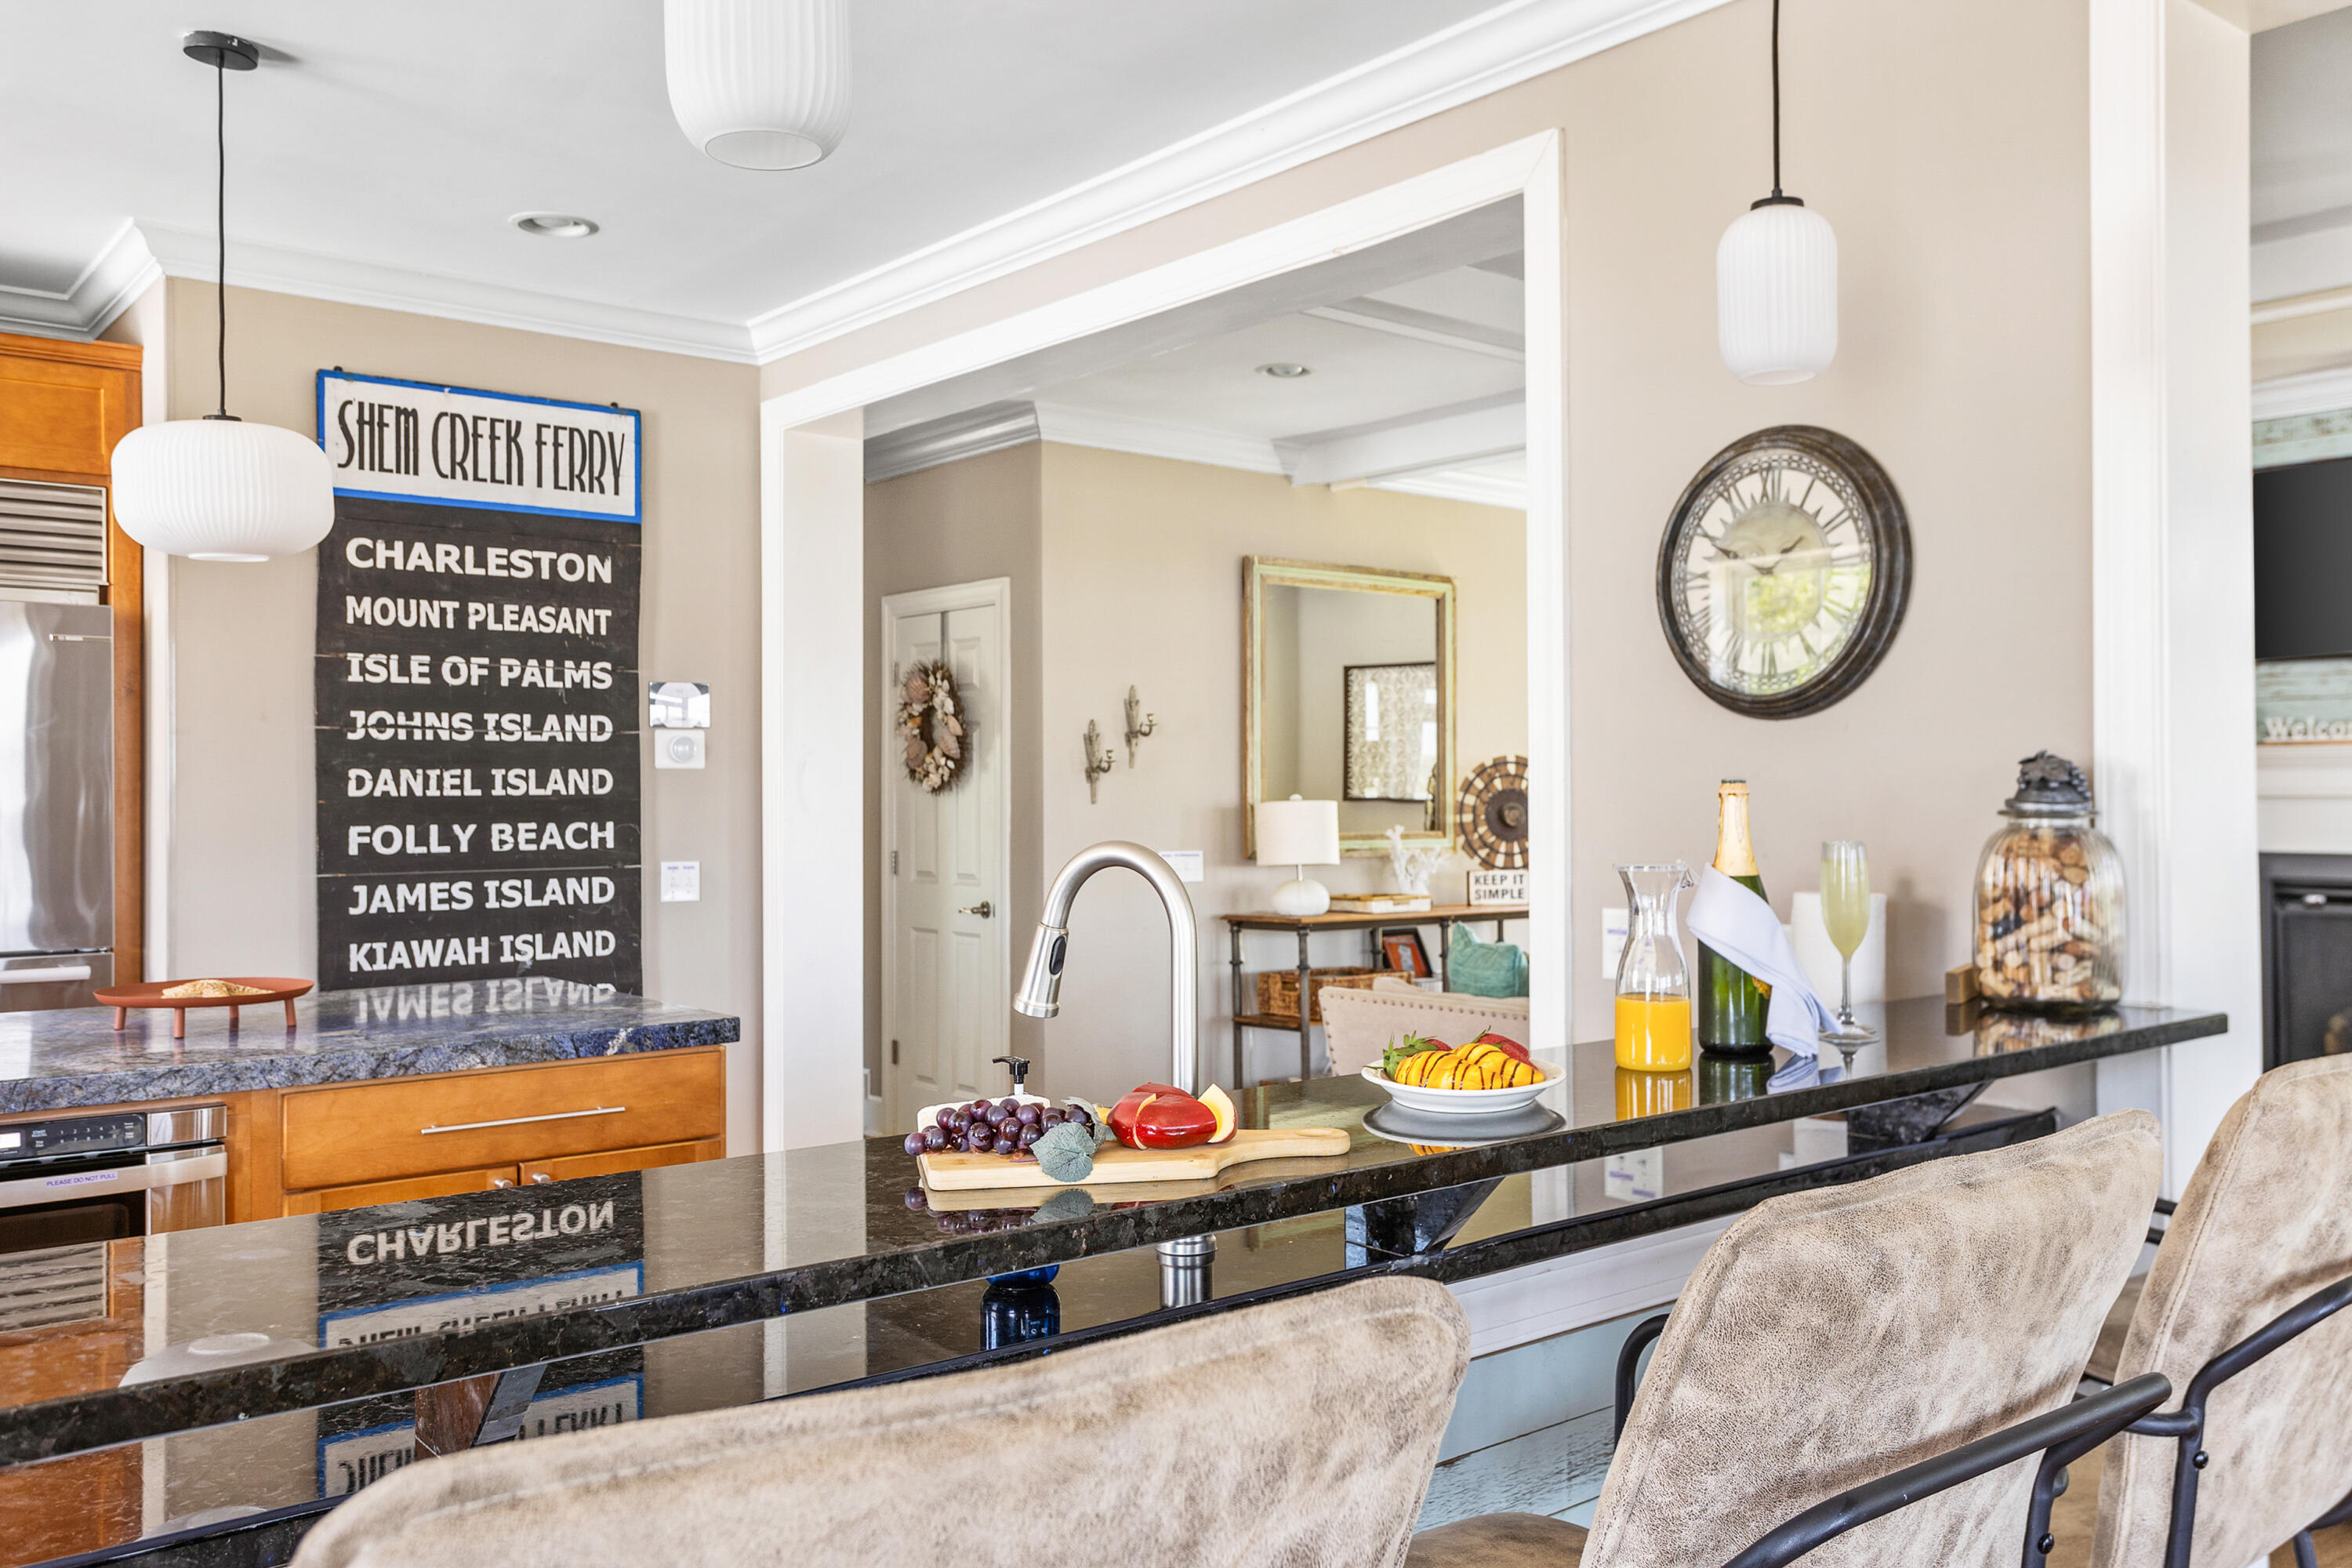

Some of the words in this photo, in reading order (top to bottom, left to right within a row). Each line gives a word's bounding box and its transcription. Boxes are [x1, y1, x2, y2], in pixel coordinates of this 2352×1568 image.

[336, 400, 420, 477] SHEM
[430, 412, 524, 487] CREEK
[535, 423, 625, 496] FERRY
[345, 537, 613, 584] CHARLESTON
[346, 595, 460, 629] MOUNT
[467, 601, 612, 637] PLEASANT
[346, 652, 431, 684] ISLE
[441, 655, 490, 687] OF
[499, 658, 613, 690] PALMS
[347, 710, 474, 742] JOHNS
[483, 713, 613, 742] ISLAND
[2265, 716, 2351, 740] Welco
[347, 768, 483, 797] DANIEL
[491, 768, 614, 797] ISLAND
[348, 823, 477, 856] FOLLY
[490, 821, 615, 852] BEACH
[348, 880, 474, 916] JAMES
[483, 877, 615, 909] ISLAND
[1475, 874, 1508, 885] KEEP
[1513, 874, 1523, 885] IT
[1475, 888, 1524, 900] SIMPLE
[349, 936, 489, 972] KIAWAH
[499, 930, 616, 964] ISLAND
